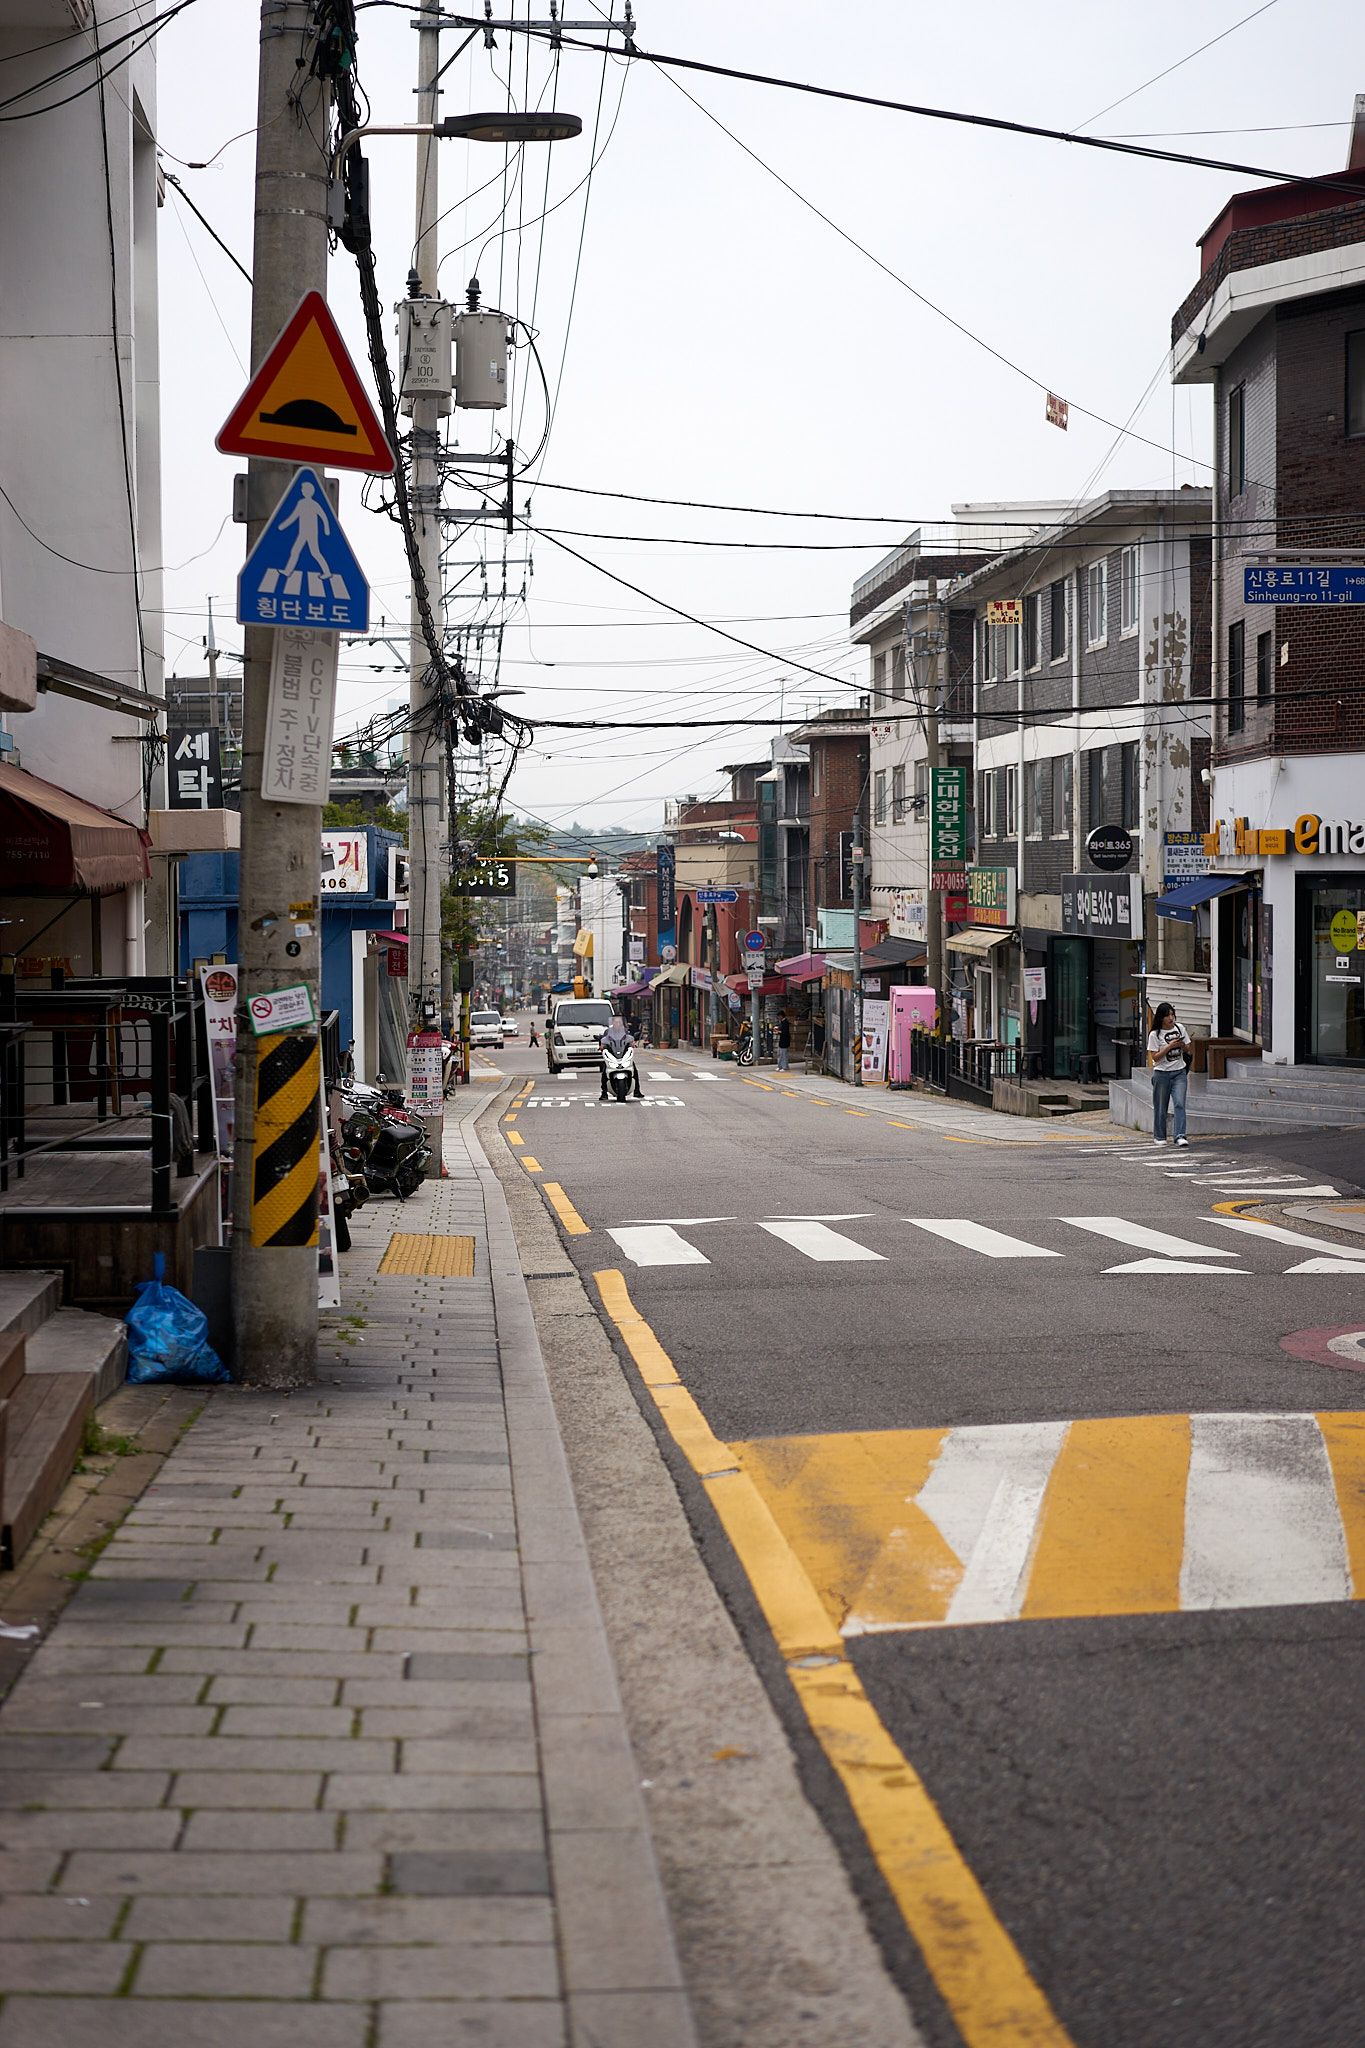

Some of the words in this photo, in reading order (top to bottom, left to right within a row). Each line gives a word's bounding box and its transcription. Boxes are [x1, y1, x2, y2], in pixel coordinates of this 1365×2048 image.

[417, 366, 434, 377] 100
[1248, 570, 1330, 588] 신흥로11길
[256, 597, 351, 623] 횡단보도
[1247, 591, 1318, 603] Sinheung-ro
[1320, 591, 1352, 603] 11-gil
[282, 654, 303, 700] 불법
[299, 657, 325, 793] CCTV단속중
[273, 708, 298, 790] 주·정차
[174, 732, 215, 809] 세탁
[936, 769, 961, 859] 근대화부동산
[1090, 839, 1131, 850] 화이트365
[1167, 833, 1197, 844] 방수공사
[932, 872, 965, 890] 792-0055
[1076, 881, 1113, 926] 화이트365
